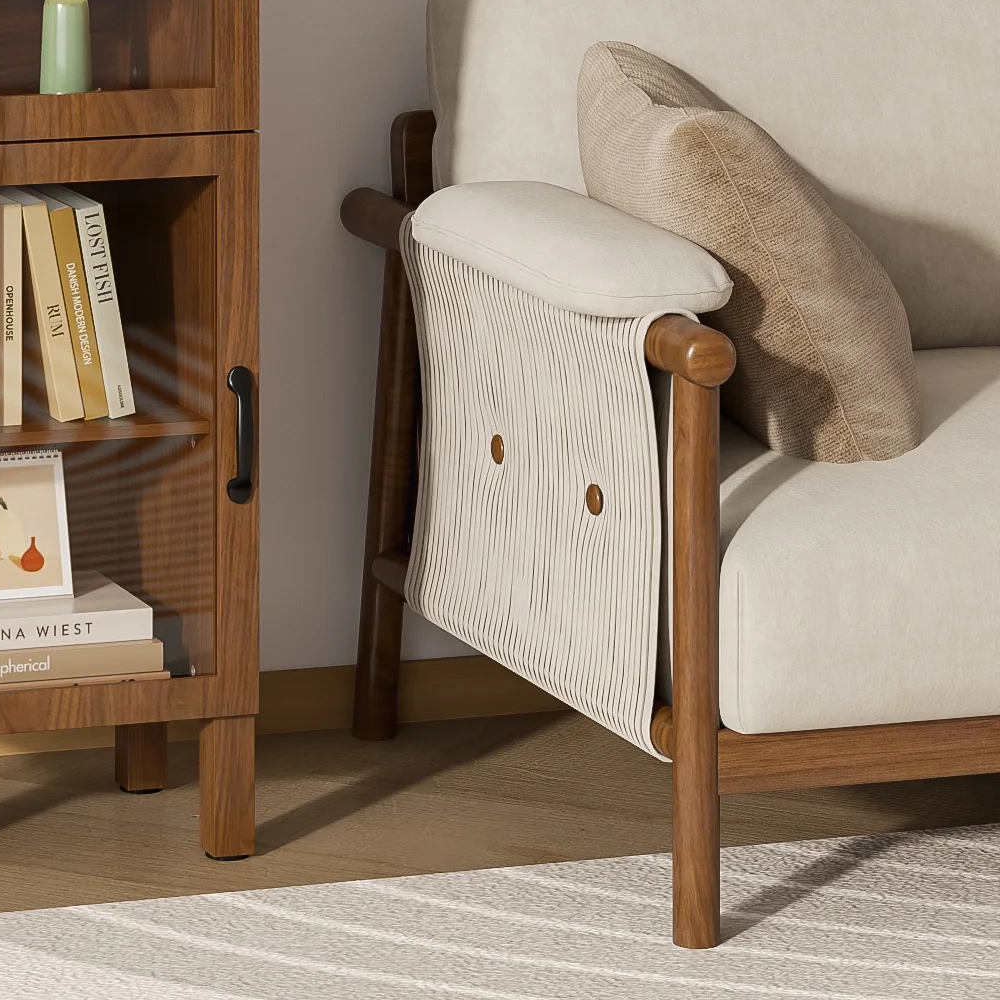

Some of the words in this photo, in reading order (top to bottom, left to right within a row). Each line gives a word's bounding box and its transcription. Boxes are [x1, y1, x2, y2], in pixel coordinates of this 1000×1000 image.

[84, 213, 106, 258] LOST
[66, 262, 83, 295] DANISH
[93, 263, 113, 304] FISH
[5, 285, 13, 341] OPENHOUSE
[47, 304, 64, 337] RUM
[72, 296, 86, 333] MODERN
[79, 334, 92, 366] DESIGN
[36, 622, 94, 638] WIEST
